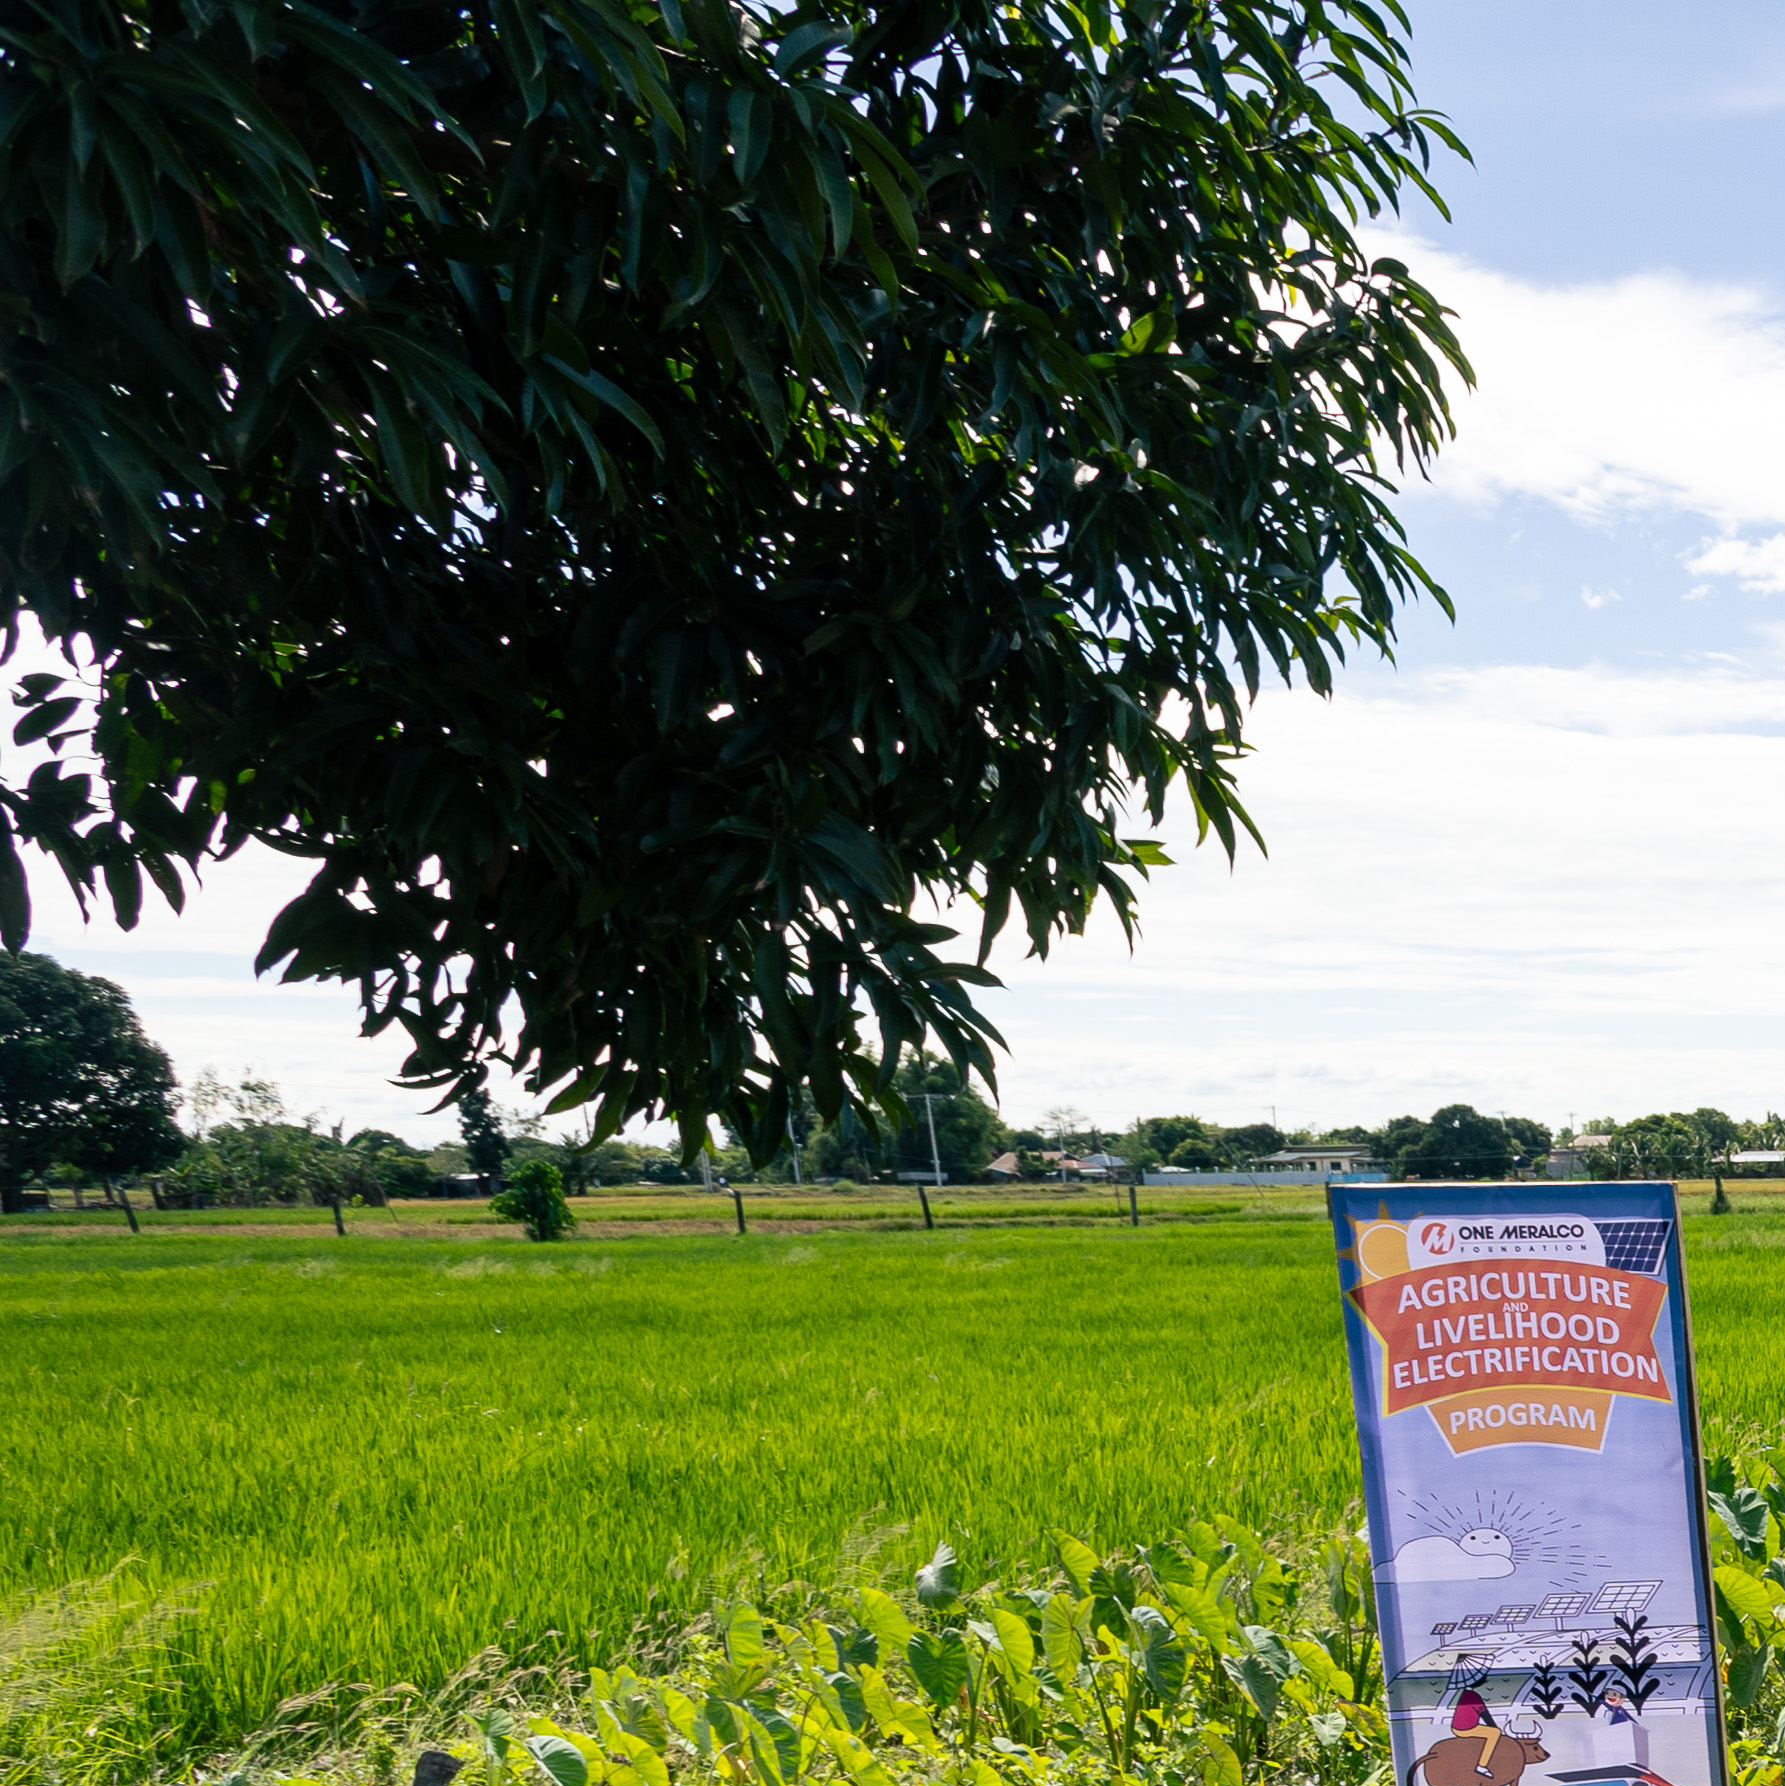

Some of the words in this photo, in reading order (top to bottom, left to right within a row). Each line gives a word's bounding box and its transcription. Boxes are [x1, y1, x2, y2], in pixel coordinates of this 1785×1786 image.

[1459, 1225, 1494, 1240] ONE
[1499, 1223, 1584, 1239] MERALCO
[1460, 1244, 1587, 1253] FOUNDATION
[1397, 1272, 1632, 1314] AGRICULTURE
[1502, 1302, 1528, 1313] AND
[1416, 1310, 1620, 1350] LIVELIHOOD
[1393, 1347, 1659, 1389] ELECTRIFICATION
[1450, 1402, 1596, 1435] PROGRAM
